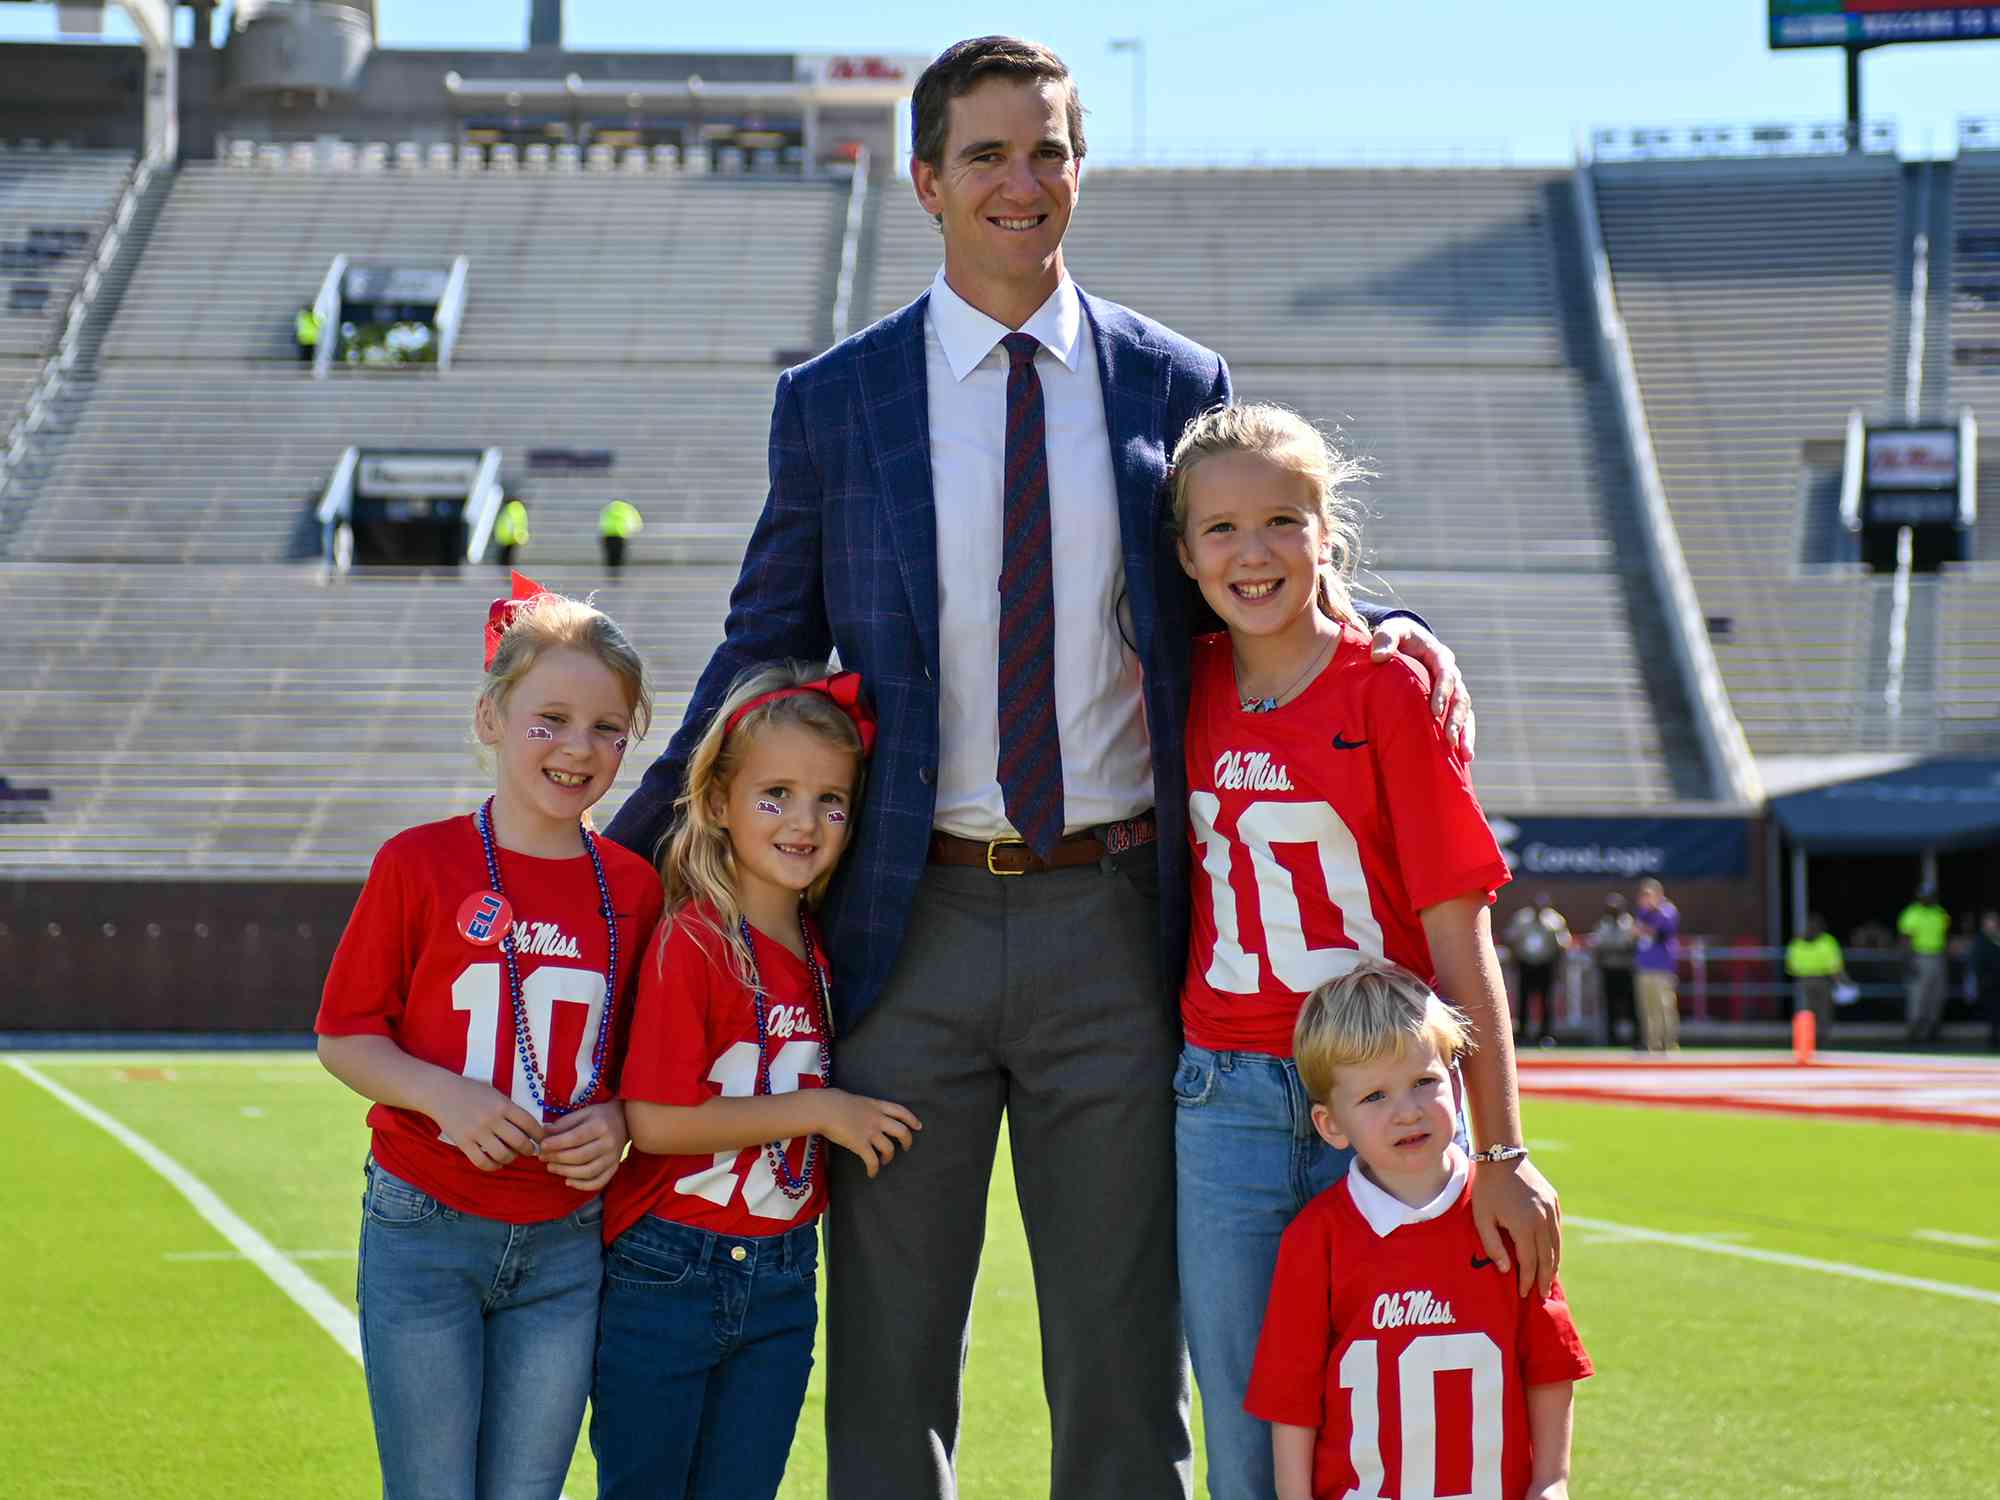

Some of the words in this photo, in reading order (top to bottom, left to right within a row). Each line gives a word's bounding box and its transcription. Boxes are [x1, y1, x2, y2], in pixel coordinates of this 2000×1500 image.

[1214, 750, 1244, 790] Ole
[1189, 791, 1396, 994] 10
[465, 896, 503, 940] ELI
[766, 1004, 795, 1038] Ole
[438, 963, 608, 1146] 10
[1372, 1292, 1405, 1330] Ole
[1339, 1332, 1504, 1500] 10
